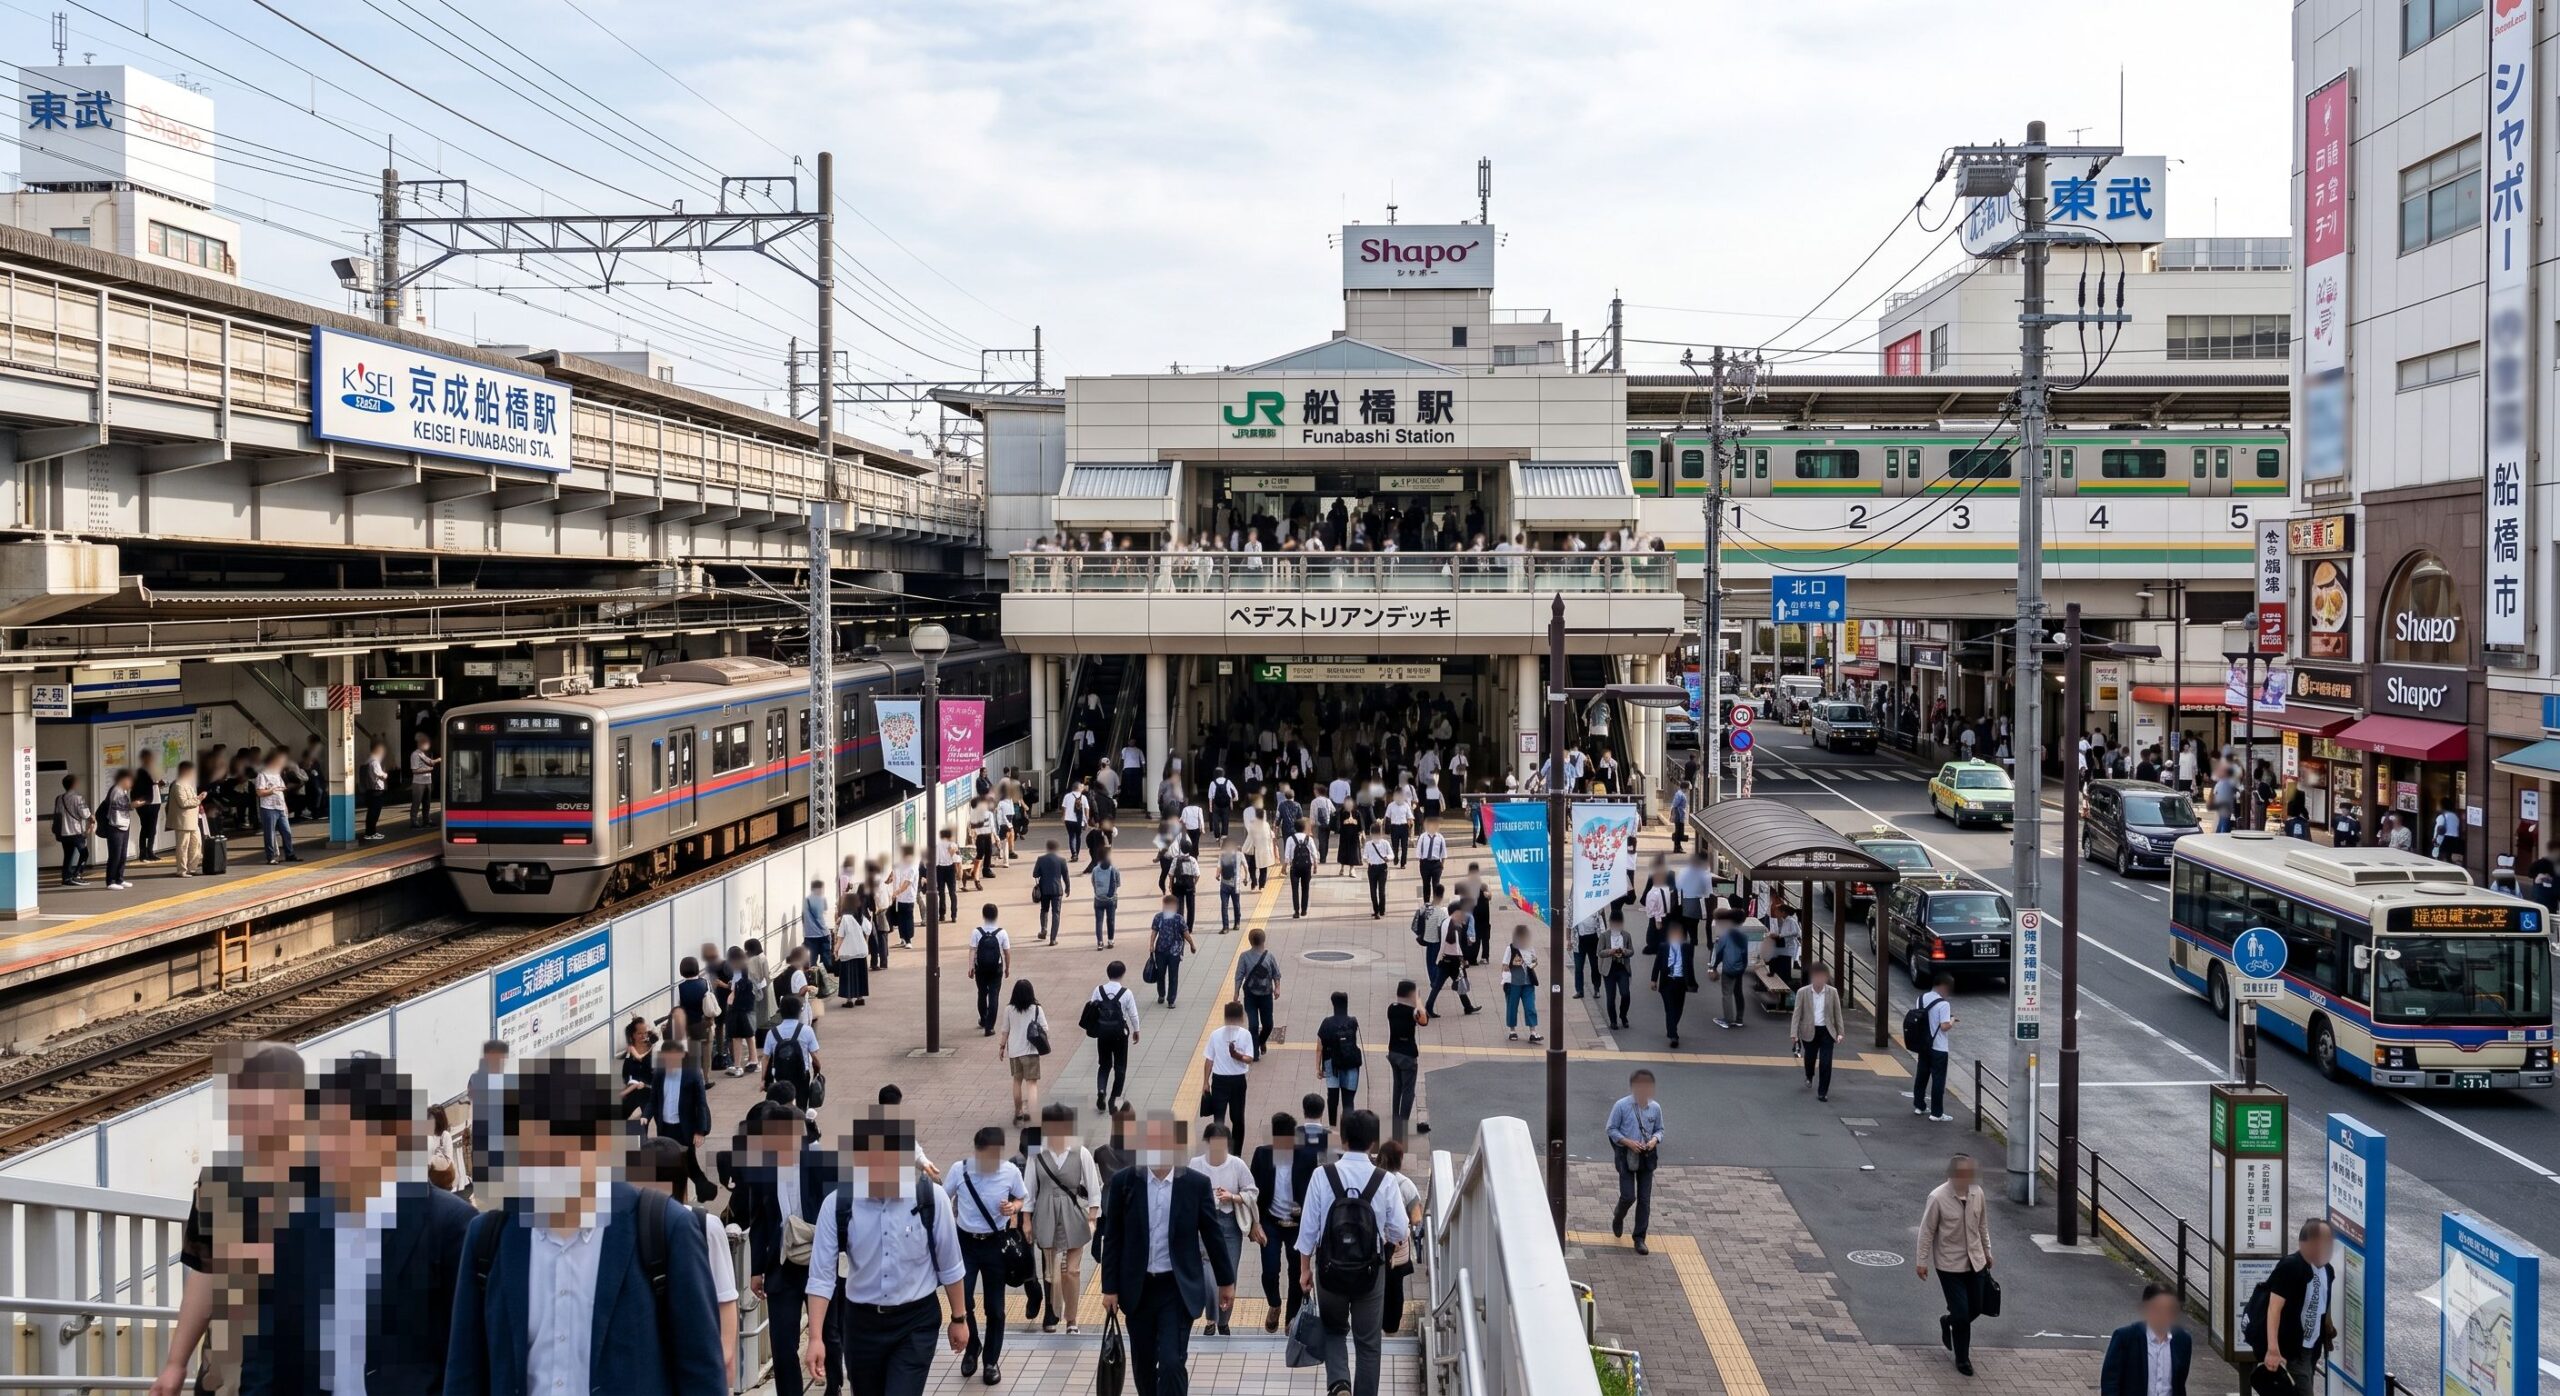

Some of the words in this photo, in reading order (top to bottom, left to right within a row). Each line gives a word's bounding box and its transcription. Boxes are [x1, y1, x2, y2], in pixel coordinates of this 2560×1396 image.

[27, 90, 113, 130] 東武
[2493, 63, 2525, 271] シャポー
[2050, 176, 2153, 221] 東武
[1360, 238, 1479, 268] Shapo
[409, 365, 557, 436] 京成船橋駅
[1223, 391, 1285, 426] JR
[1303, 388, 1454, 425] 船橋駅
[413, 420, 456, 443] KEISEI
[460, 428, 527, 455] FUNABASHI
[530, 440, 554, 459] STA.
[1303, 429, 1390, 444] Funabashi
[1395, 429, 1455, 444] Station
[1731, 505, 1741, 528] 1
[1849, 505, 1868, 529] 2
[1953, 505, 1970, 529] 3
[2089, 505, 2109, 529] 4
[2231, 504, 2249, 529] 5
[2493, 461, 2520, 618] 船橋市
[1791, 579, 1826, 595] 北口
[1229, 605, 1452, 628] ペデストリアンデッキ
[1262, 665, 1282, 678] JR
[2387, 676, 2447, 712] Shapo
